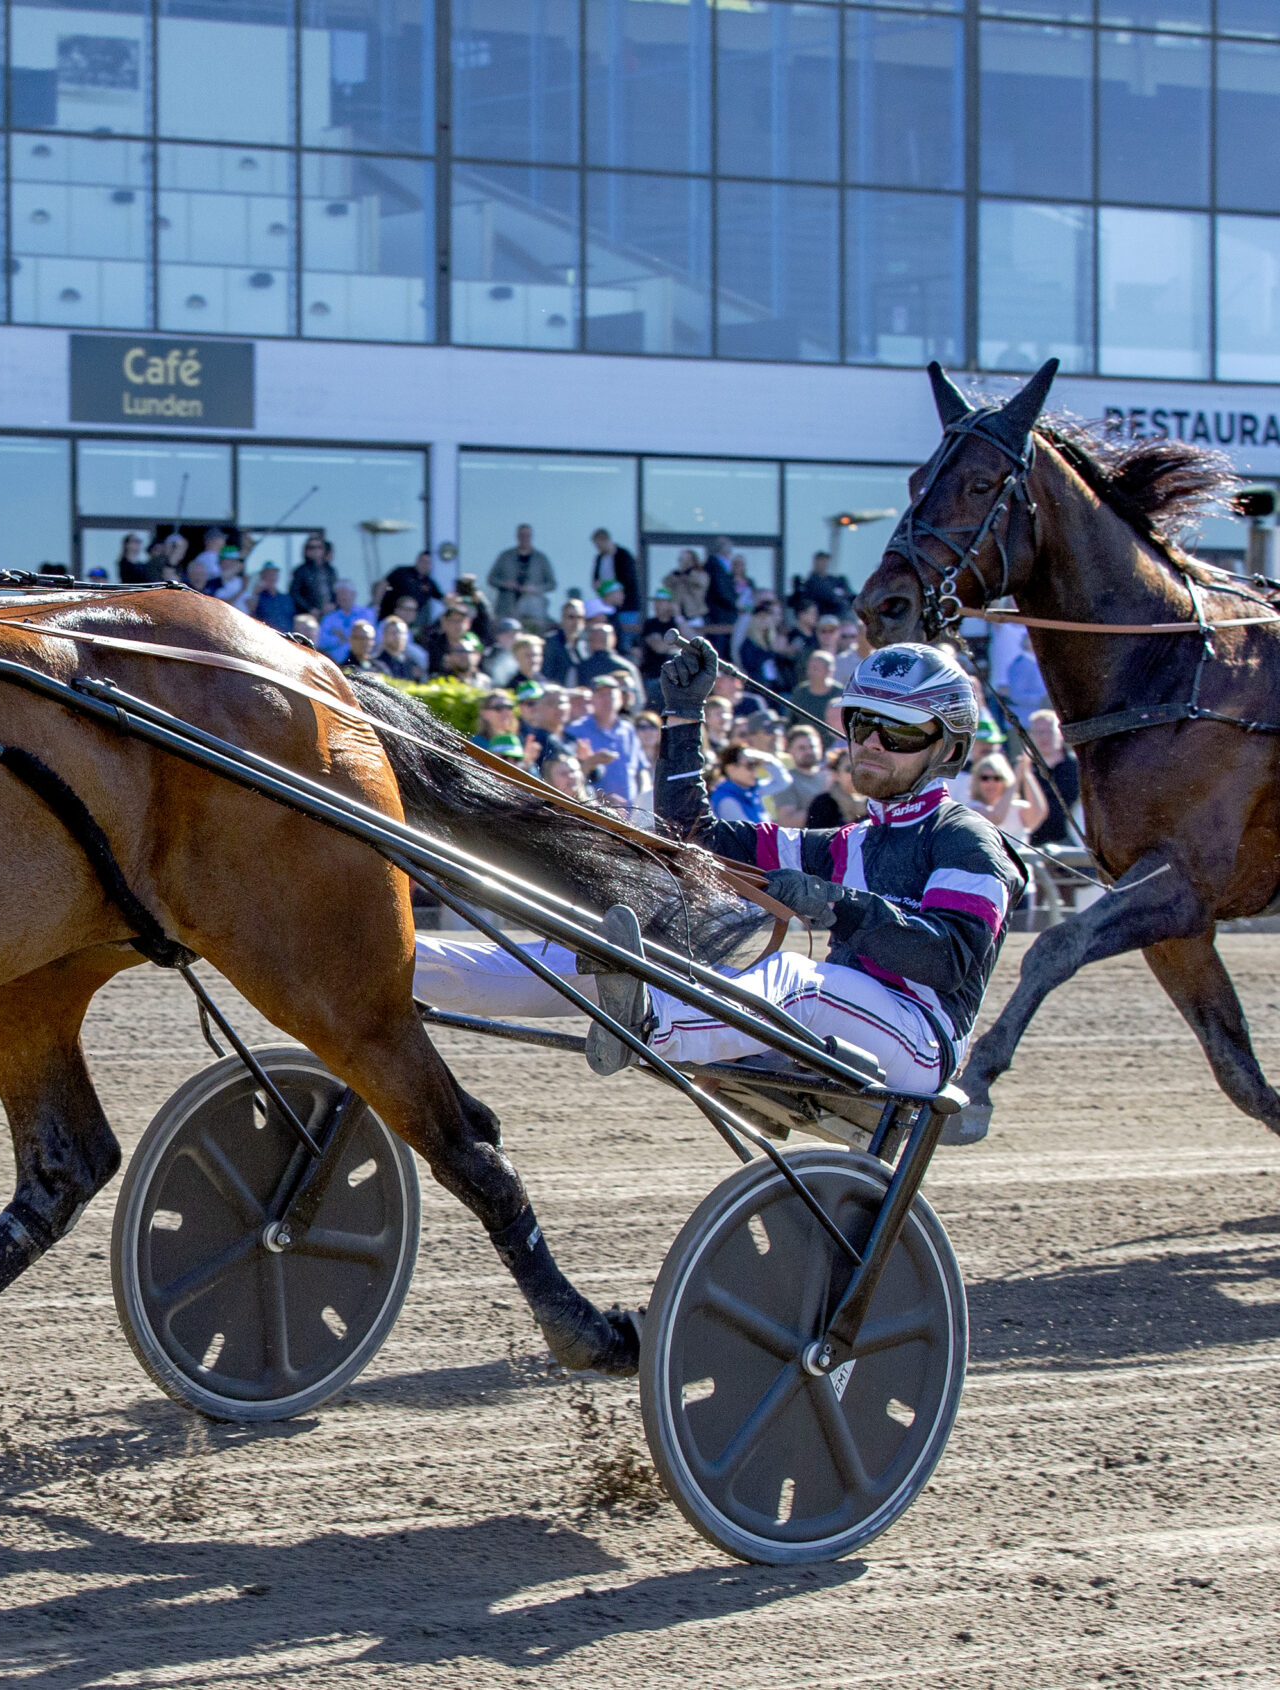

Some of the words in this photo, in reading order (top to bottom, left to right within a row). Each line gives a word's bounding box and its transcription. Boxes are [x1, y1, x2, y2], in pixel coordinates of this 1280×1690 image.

[124, 347, 202, 386] Café
[123, 392, 204, 417] Lunden
[834, 1364, 849, 1394] FMT
